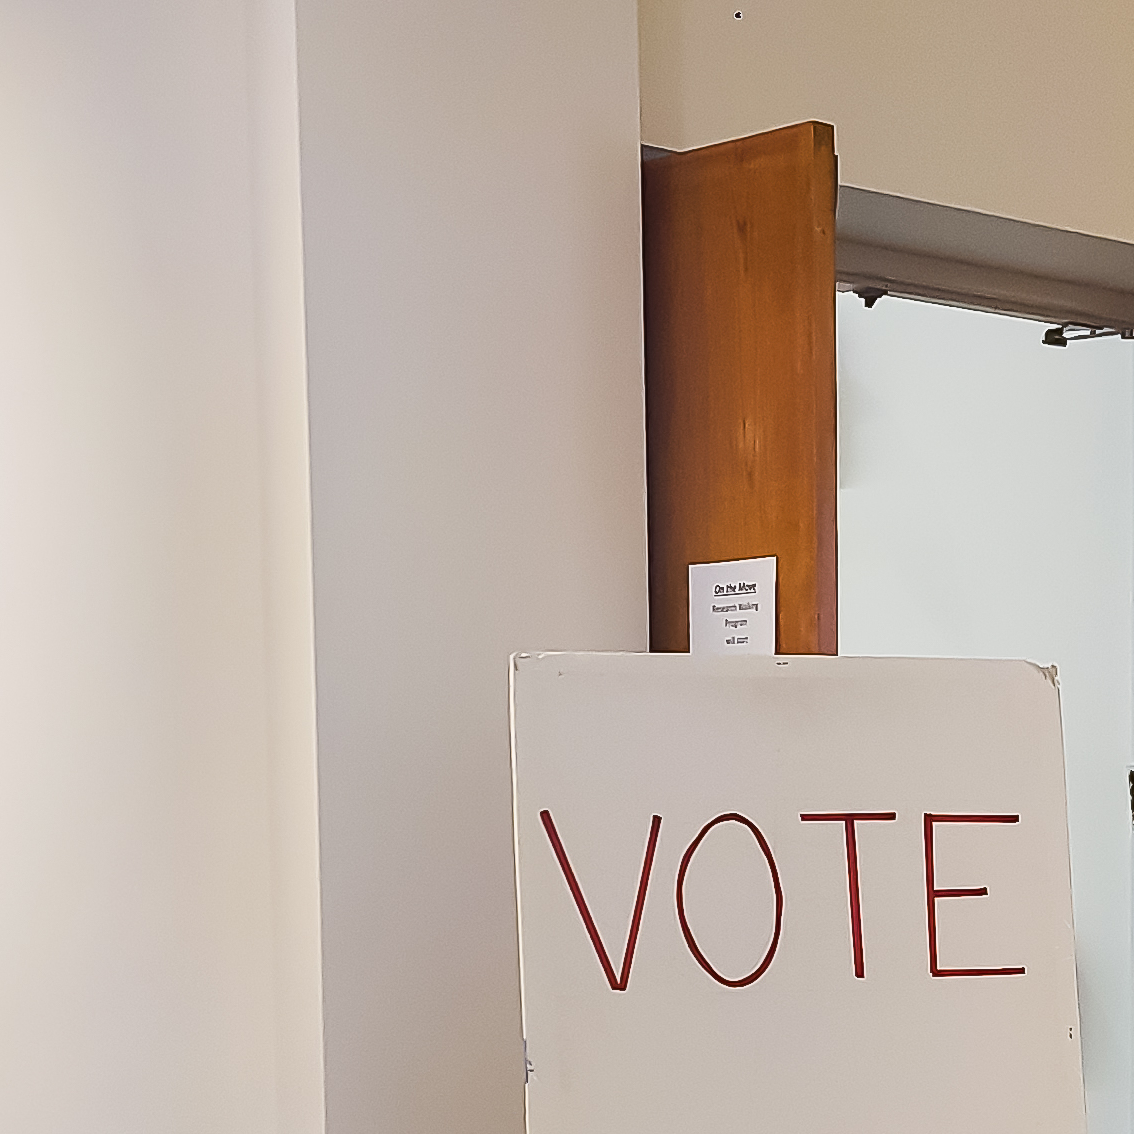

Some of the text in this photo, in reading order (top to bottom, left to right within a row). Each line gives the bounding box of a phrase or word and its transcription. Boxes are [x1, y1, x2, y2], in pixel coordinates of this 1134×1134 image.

[714, 582, 757, 595] On the Move
[540, 809, 1026, 991] VOTE
